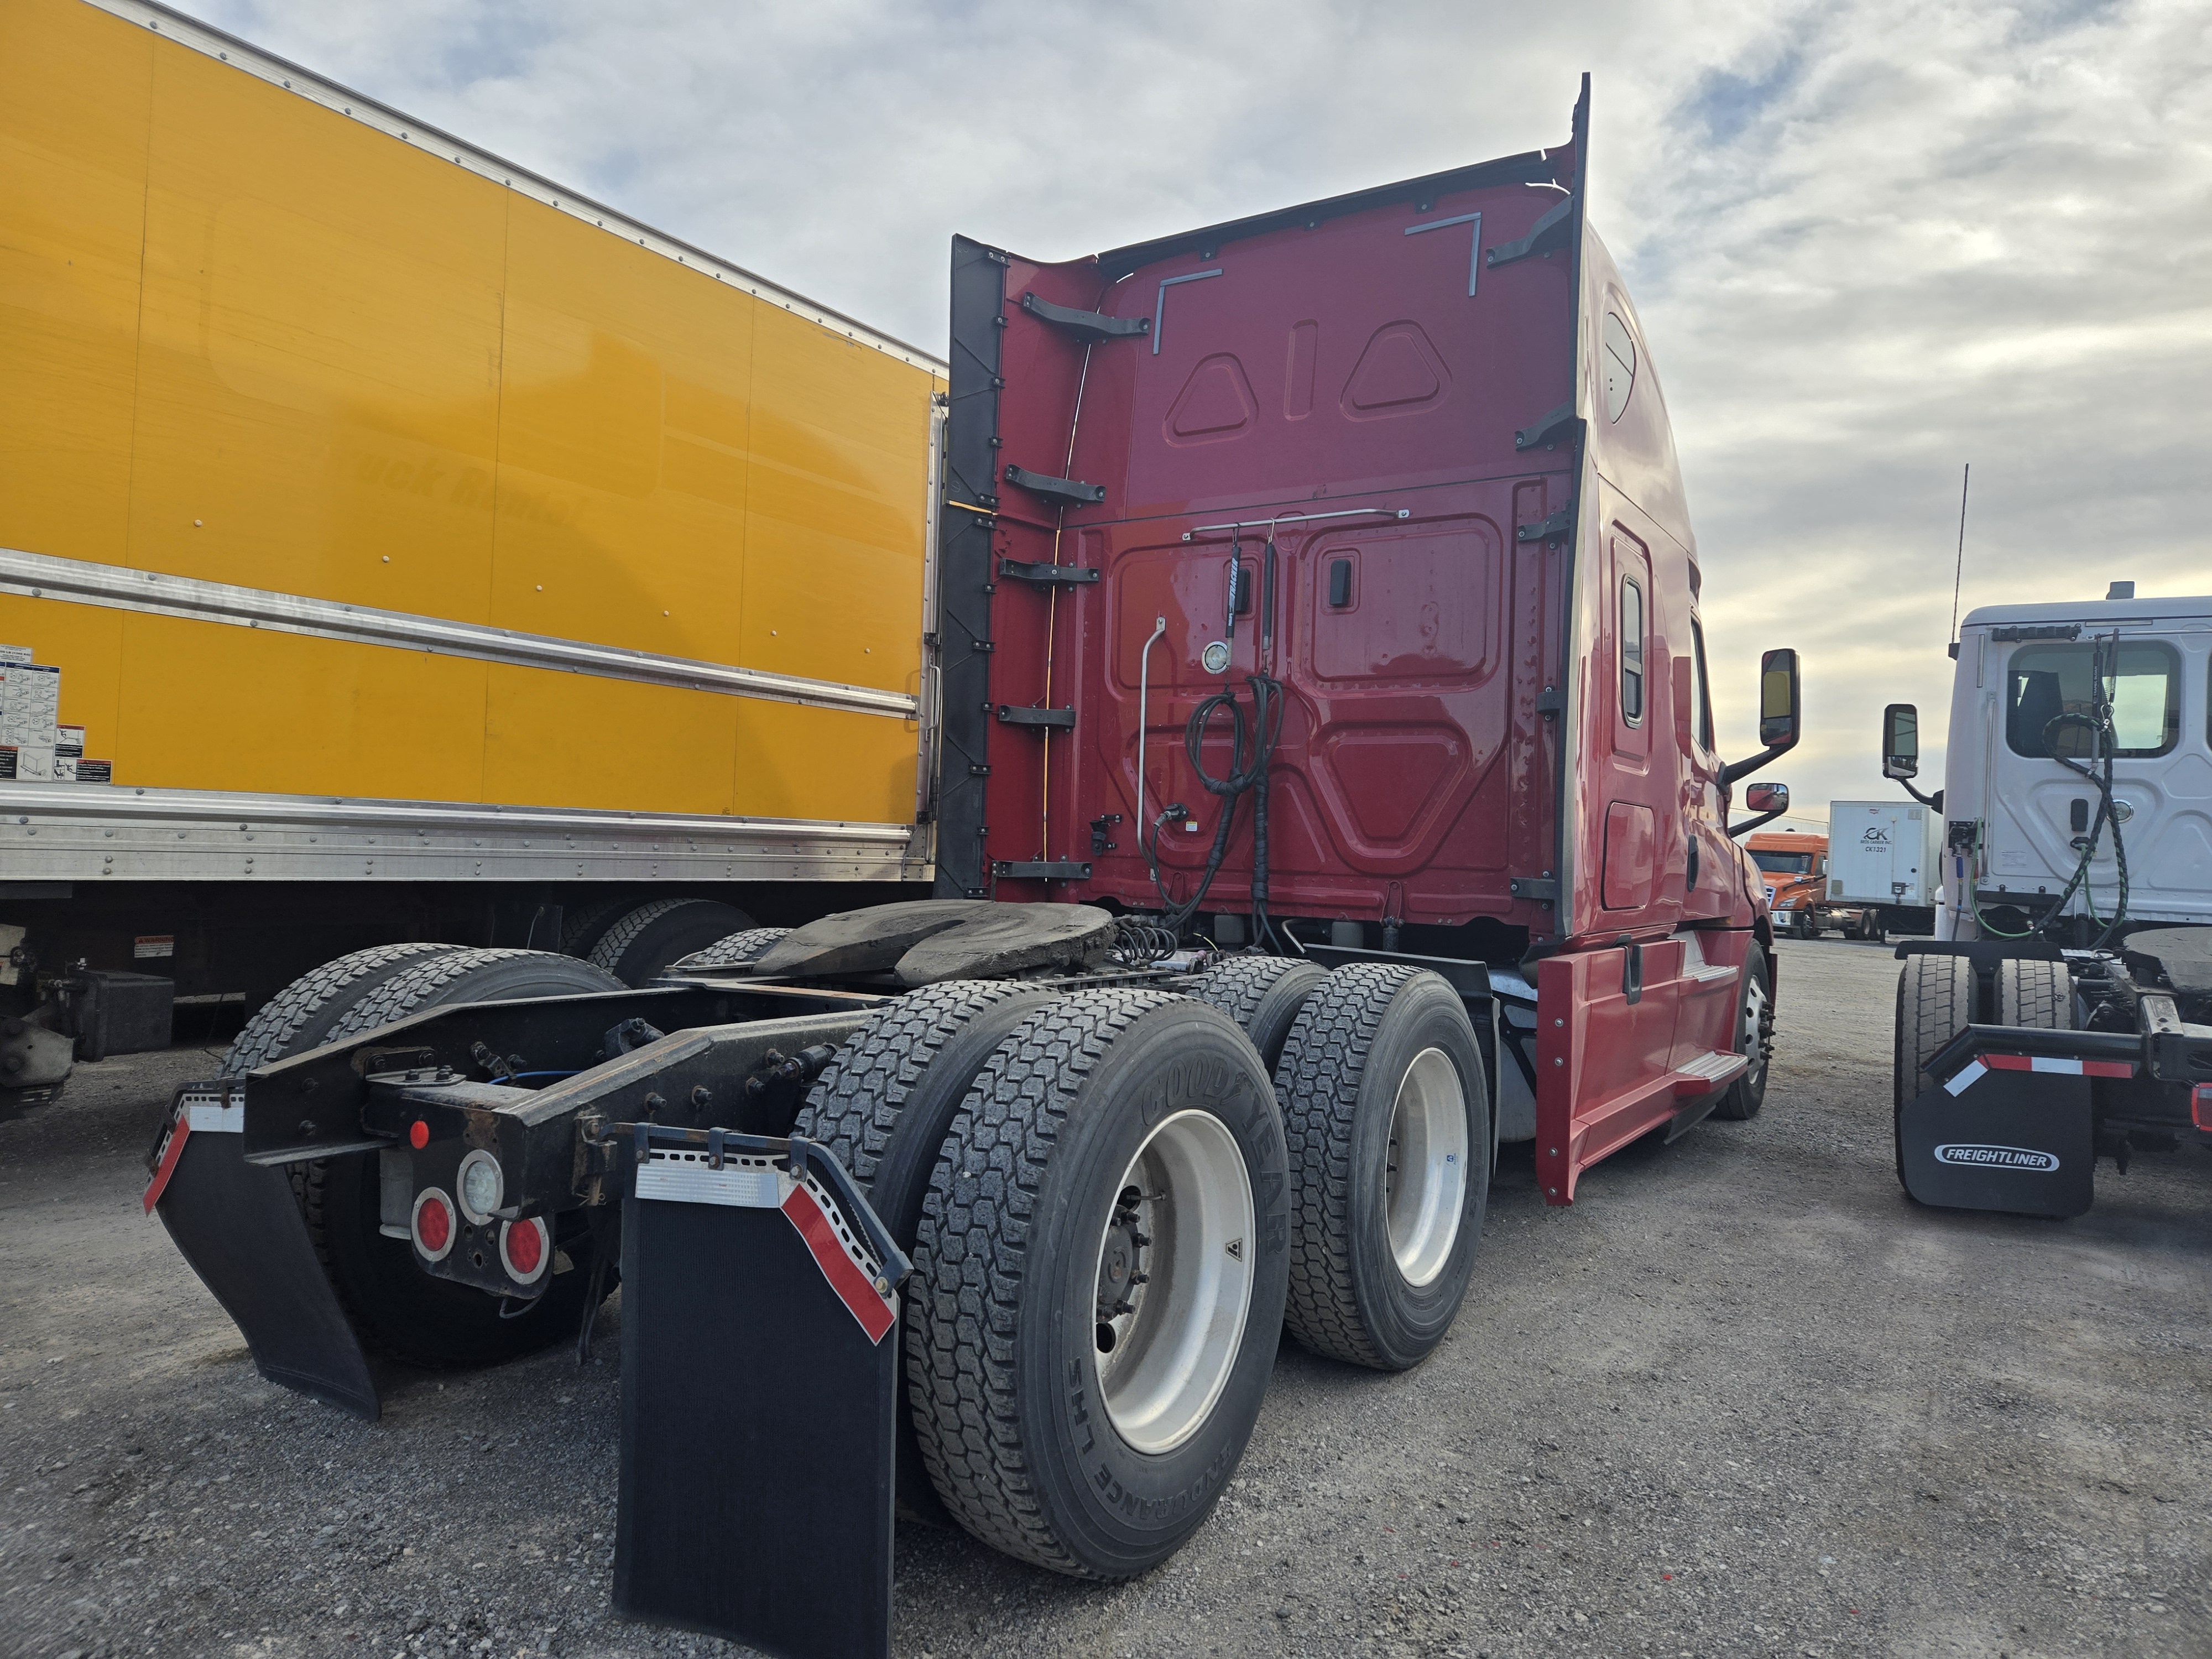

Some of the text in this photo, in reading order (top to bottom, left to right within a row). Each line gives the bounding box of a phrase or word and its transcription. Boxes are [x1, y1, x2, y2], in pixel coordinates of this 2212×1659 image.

[1229, 557, 1238, 599] TRACKER
[1863, 827, 1890, 840] CK
[1143, 1053, 1287, 1255] GOODYEAR
[1946, 1148, 2047, 1167] FREIGHTLINER
[1068, 1357, 1232, 1520] ENDURANCE LHS
